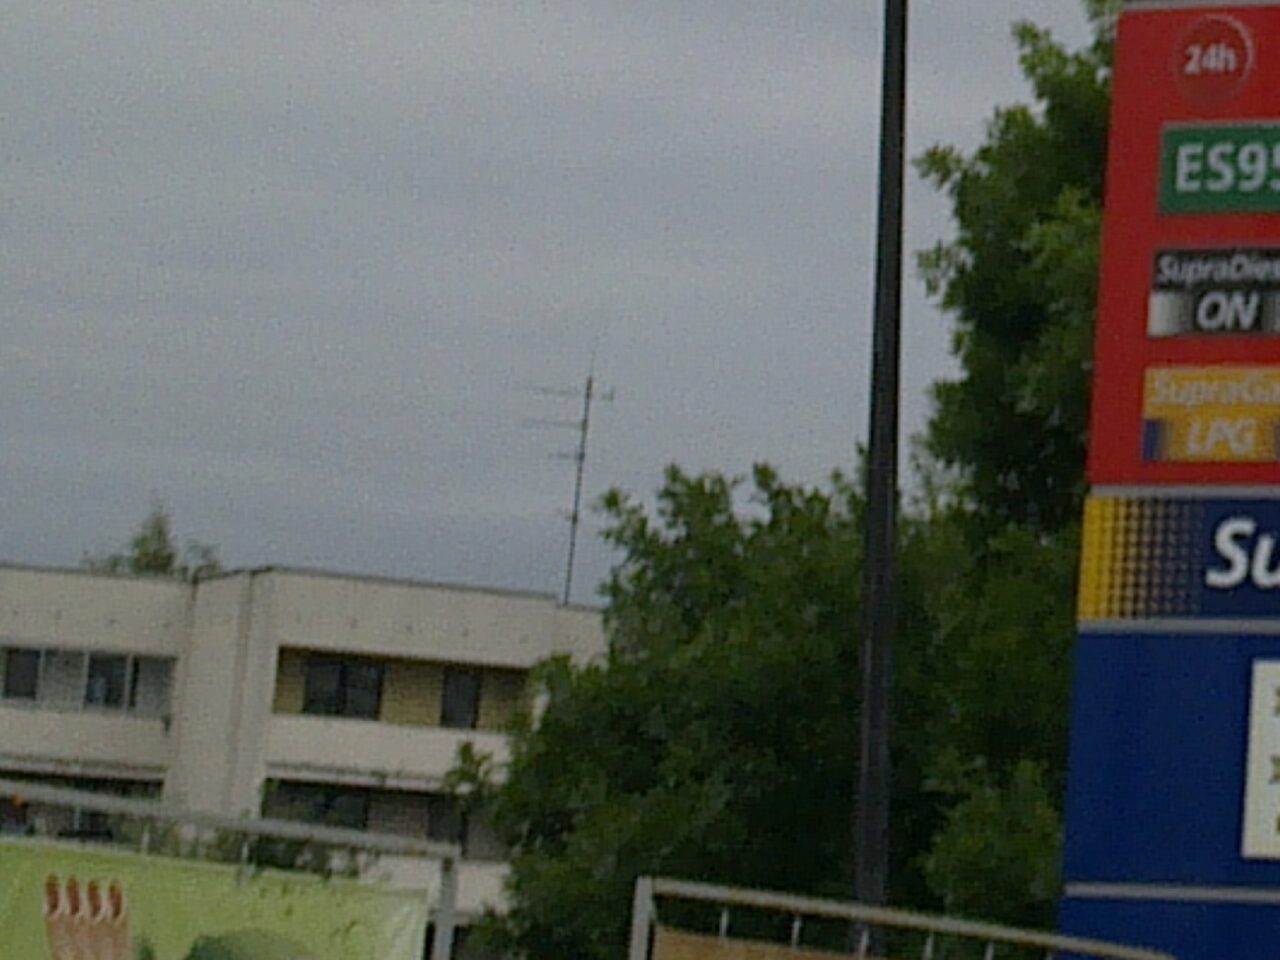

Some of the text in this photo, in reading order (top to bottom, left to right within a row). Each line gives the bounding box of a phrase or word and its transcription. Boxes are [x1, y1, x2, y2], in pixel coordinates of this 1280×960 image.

[1183, 43, 1237, 76] 24h
[1196, 291, 1260, 330] ON
[1186, 418, 1257, 455] LPG
